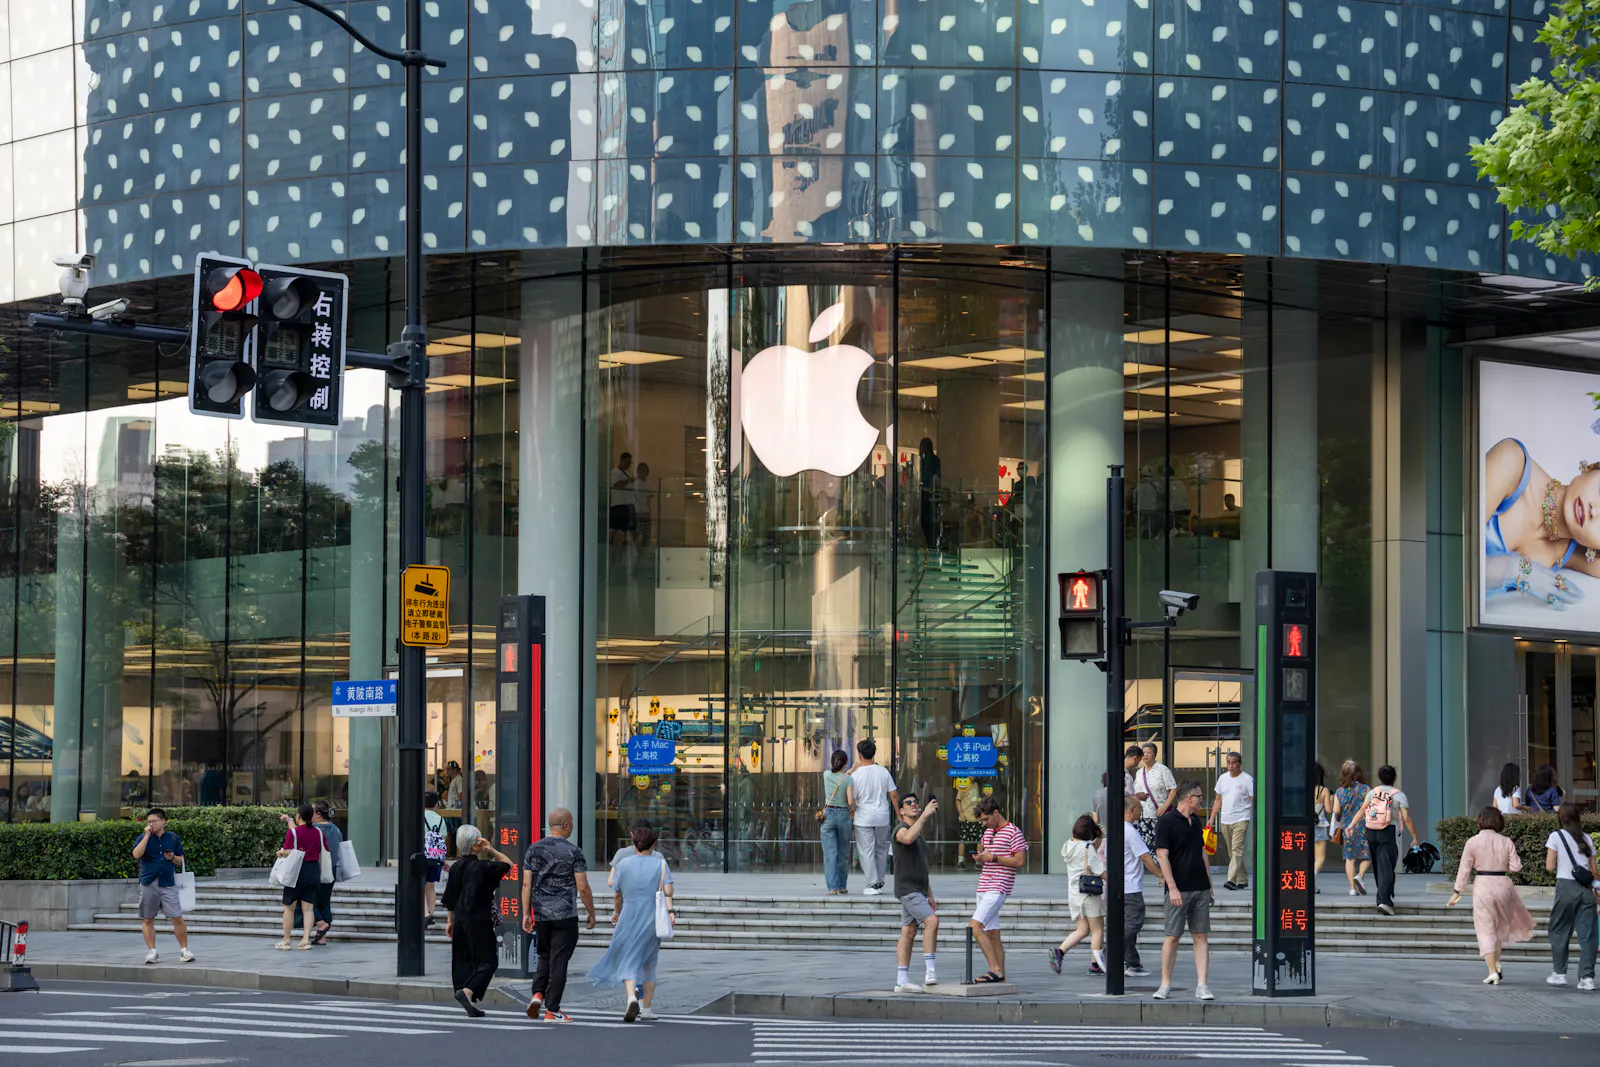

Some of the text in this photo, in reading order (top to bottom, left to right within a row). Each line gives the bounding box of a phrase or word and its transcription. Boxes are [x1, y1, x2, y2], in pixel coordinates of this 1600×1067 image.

[309, 291, 333, 410] 右转控制
[405, 598, 445, 608] 停车行为违法
[407, 609, 443, 619] 请立即驶离
[405, 619, 446, 629] 电子警察监管
[335, 684, 396, 701] 北 黄陂南路 南
[390, 705, 395, 713] S
[634, 740, 669, 749] 入手 Mac
[954, 742, 991, 751] 入手 iPad
[634, 751, 658, 760] 上高校
[954, 753, 980, 763] 上高校
[500, 827, 519, 846] 遵守
[1280, 829, 1307, 851] 遵守
[1281, 870, 1307, 890] 交通
[500, 896, 520, 917] 信号
[1280, 908, 1308, 930] 信号
